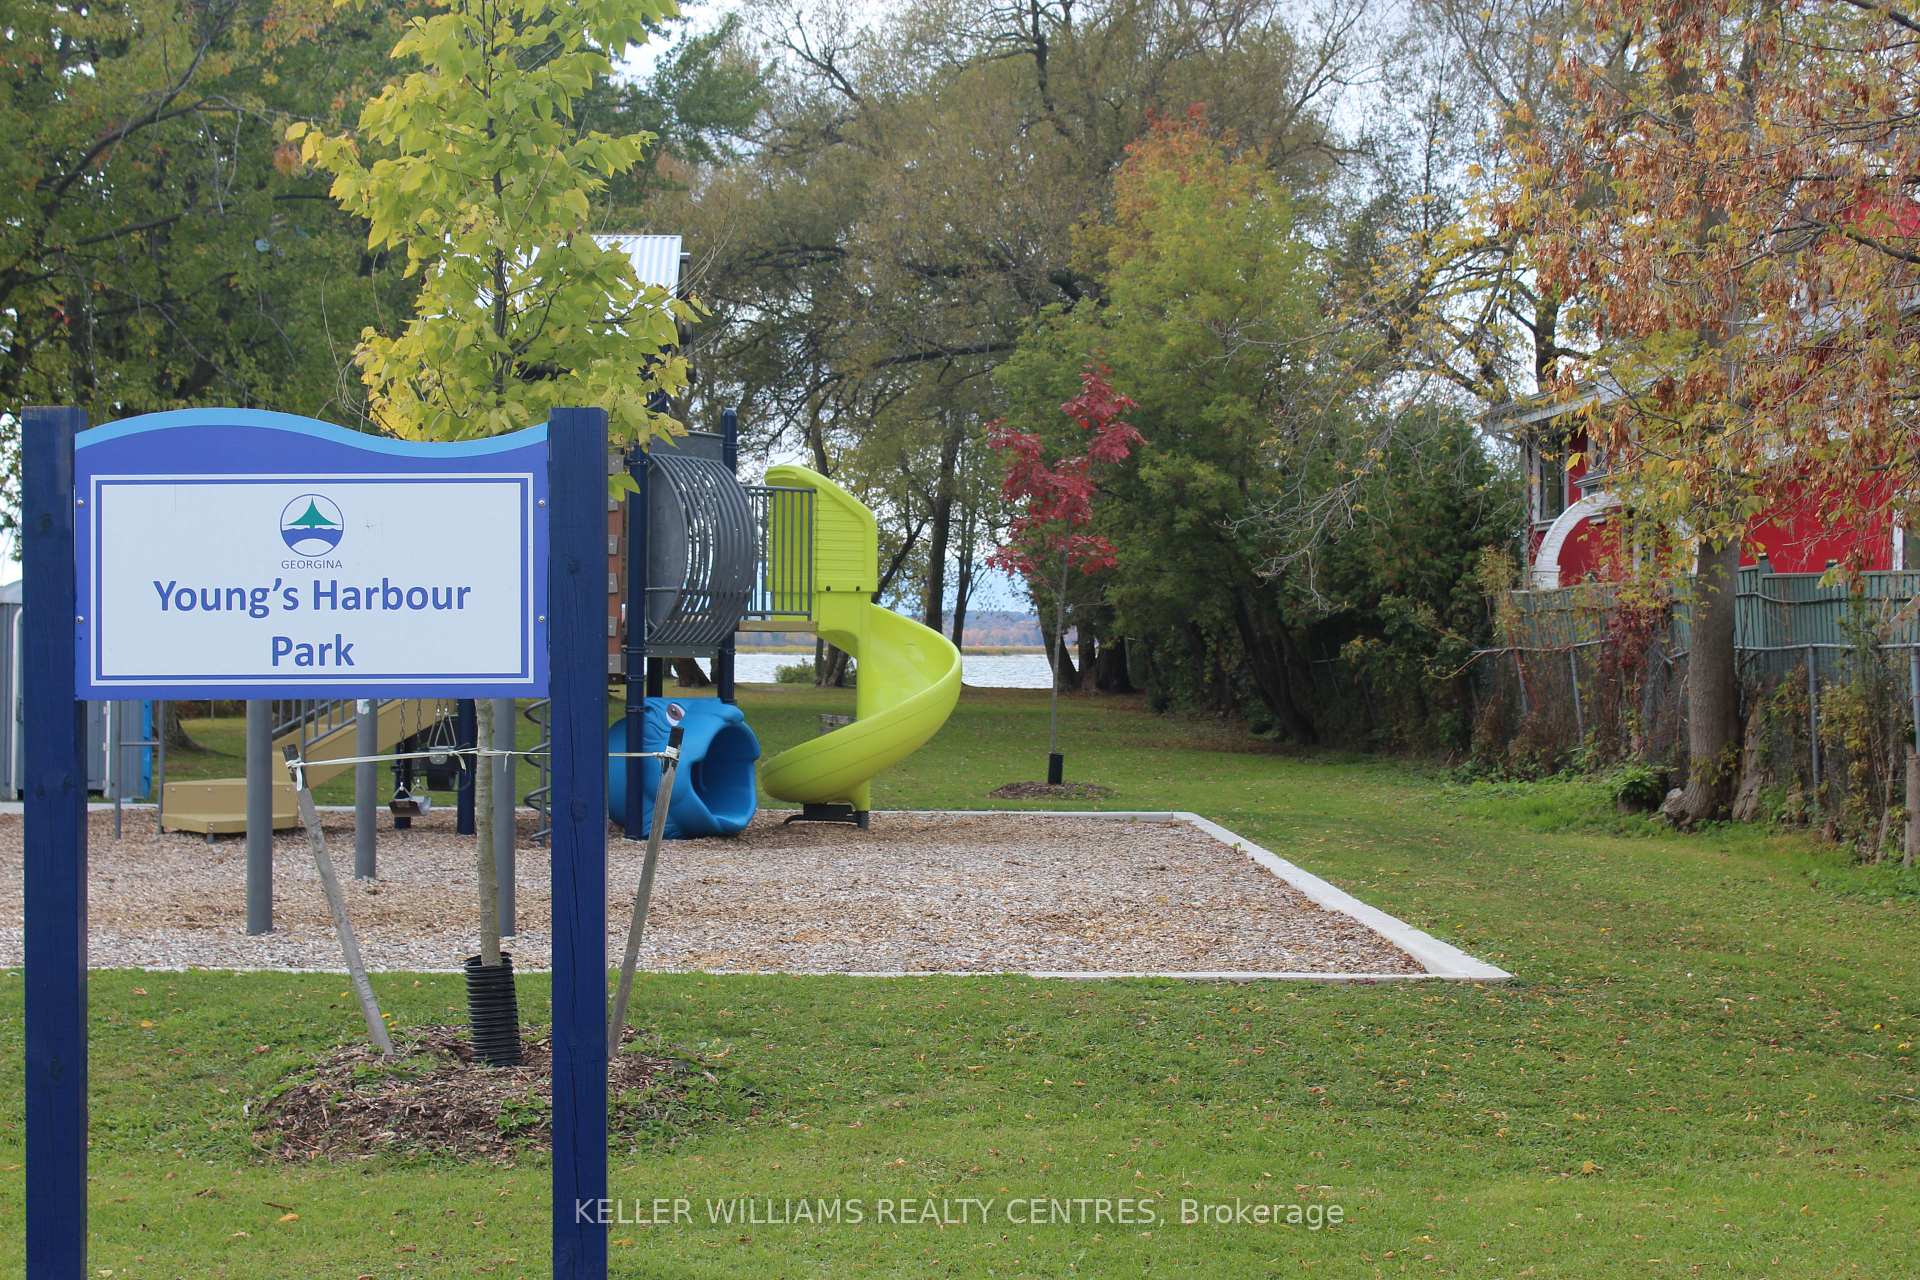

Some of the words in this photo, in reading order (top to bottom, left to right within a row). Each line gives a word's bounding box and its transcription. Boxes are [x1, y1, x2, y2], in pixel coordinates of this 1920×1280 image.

[281, 559, 343, 570] GEORGINA
[153, 578, 299, 618] Young’s
[313, 578, 471, 611] Harbour
[271, 634, 355, 667] Park
